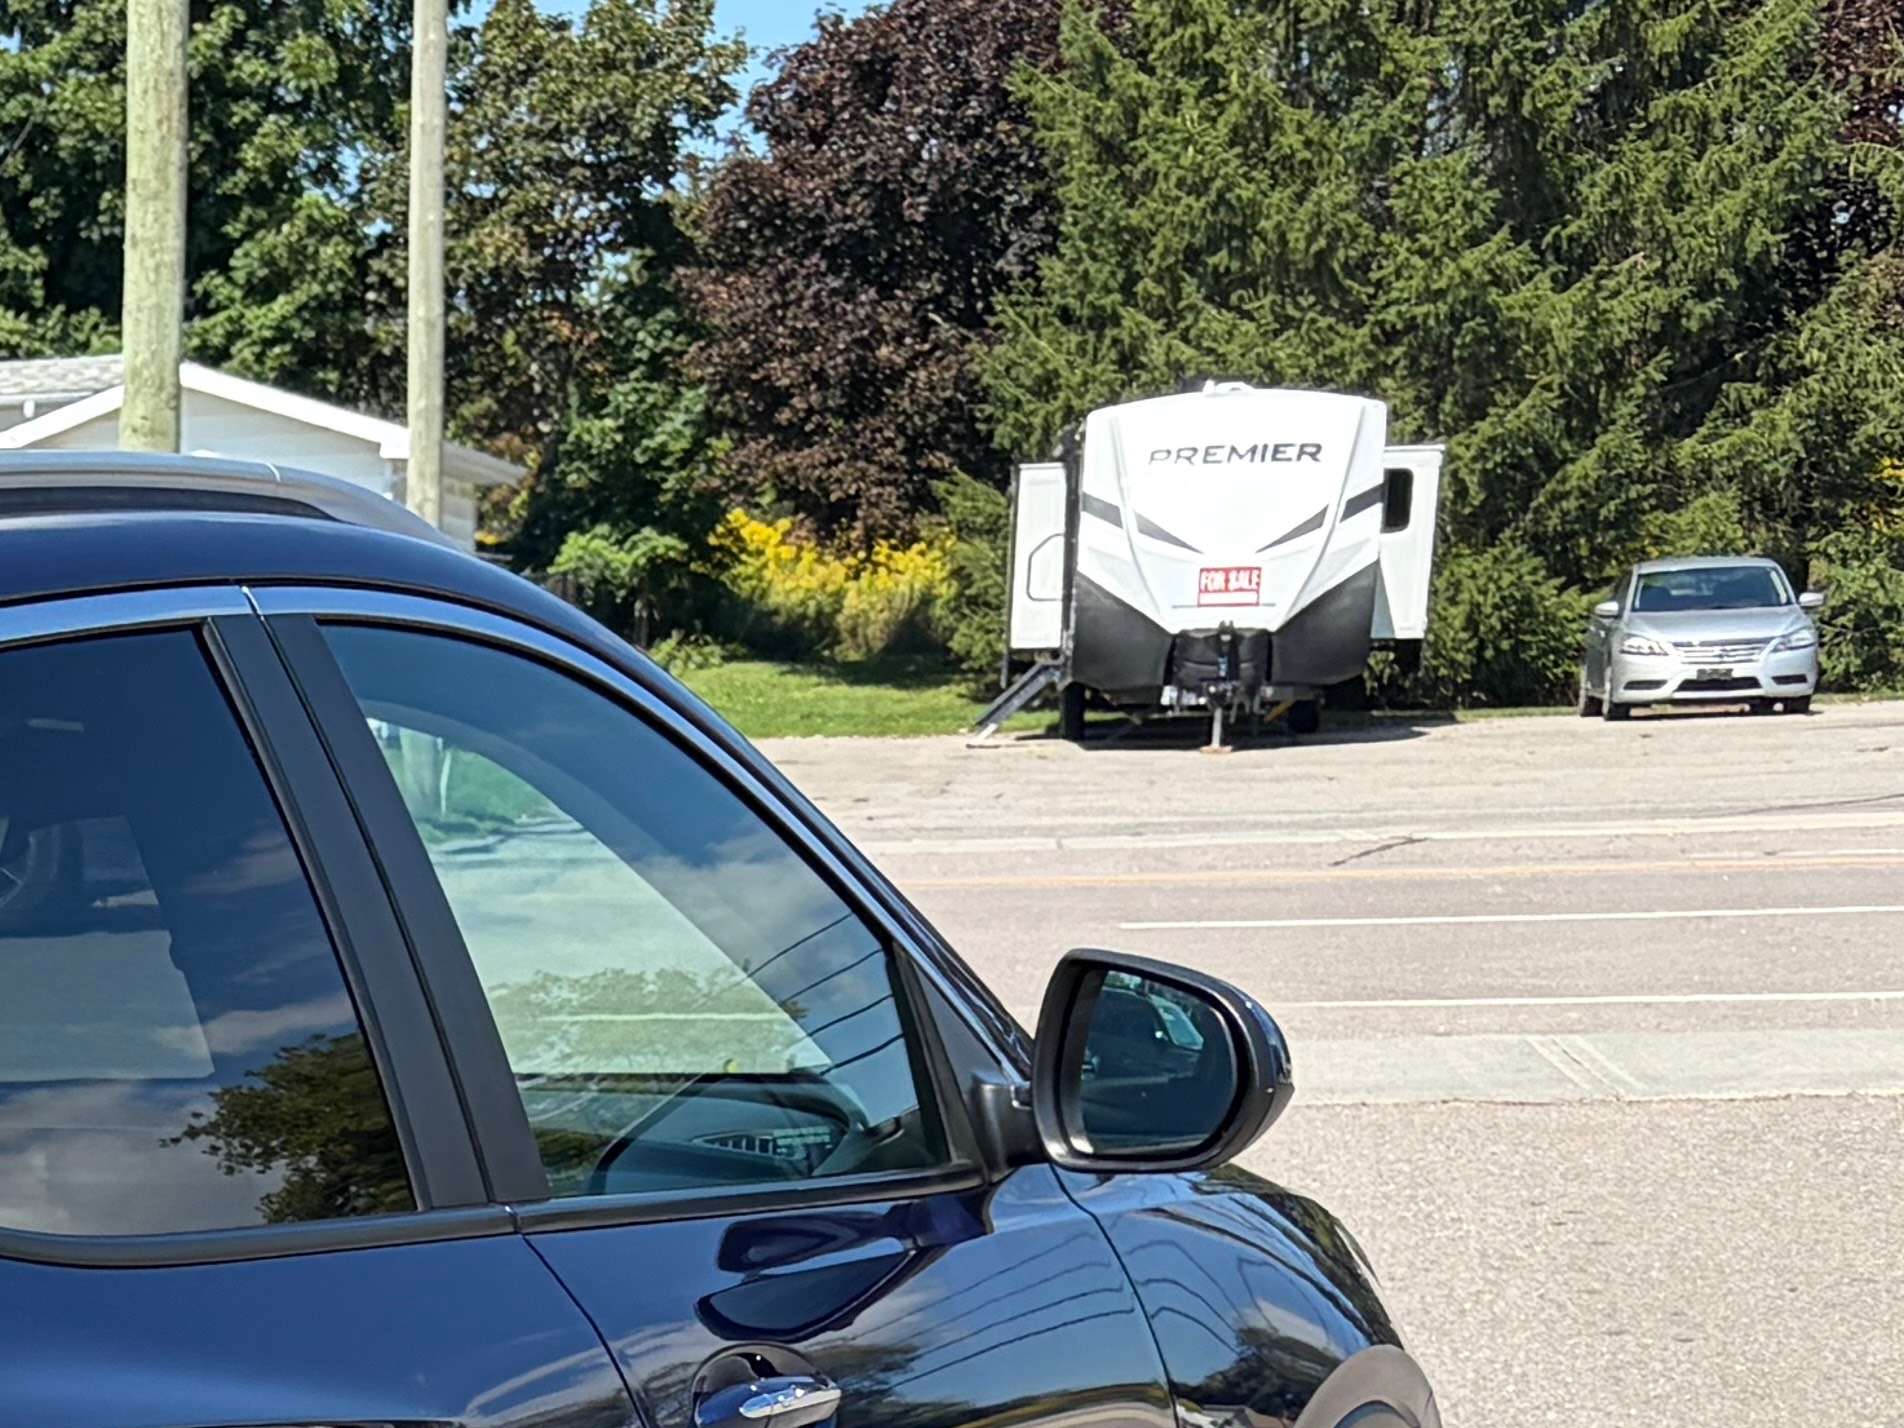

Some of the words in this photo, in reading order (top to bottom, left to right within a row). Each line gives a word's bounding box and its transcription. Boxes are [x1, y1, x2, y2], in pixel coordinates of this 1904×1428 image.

[1149, 442, 1323, 466] PREMIER
[1200, 570, 1226, 592] FOR
[1228, 568, 1260, 592] SALE
